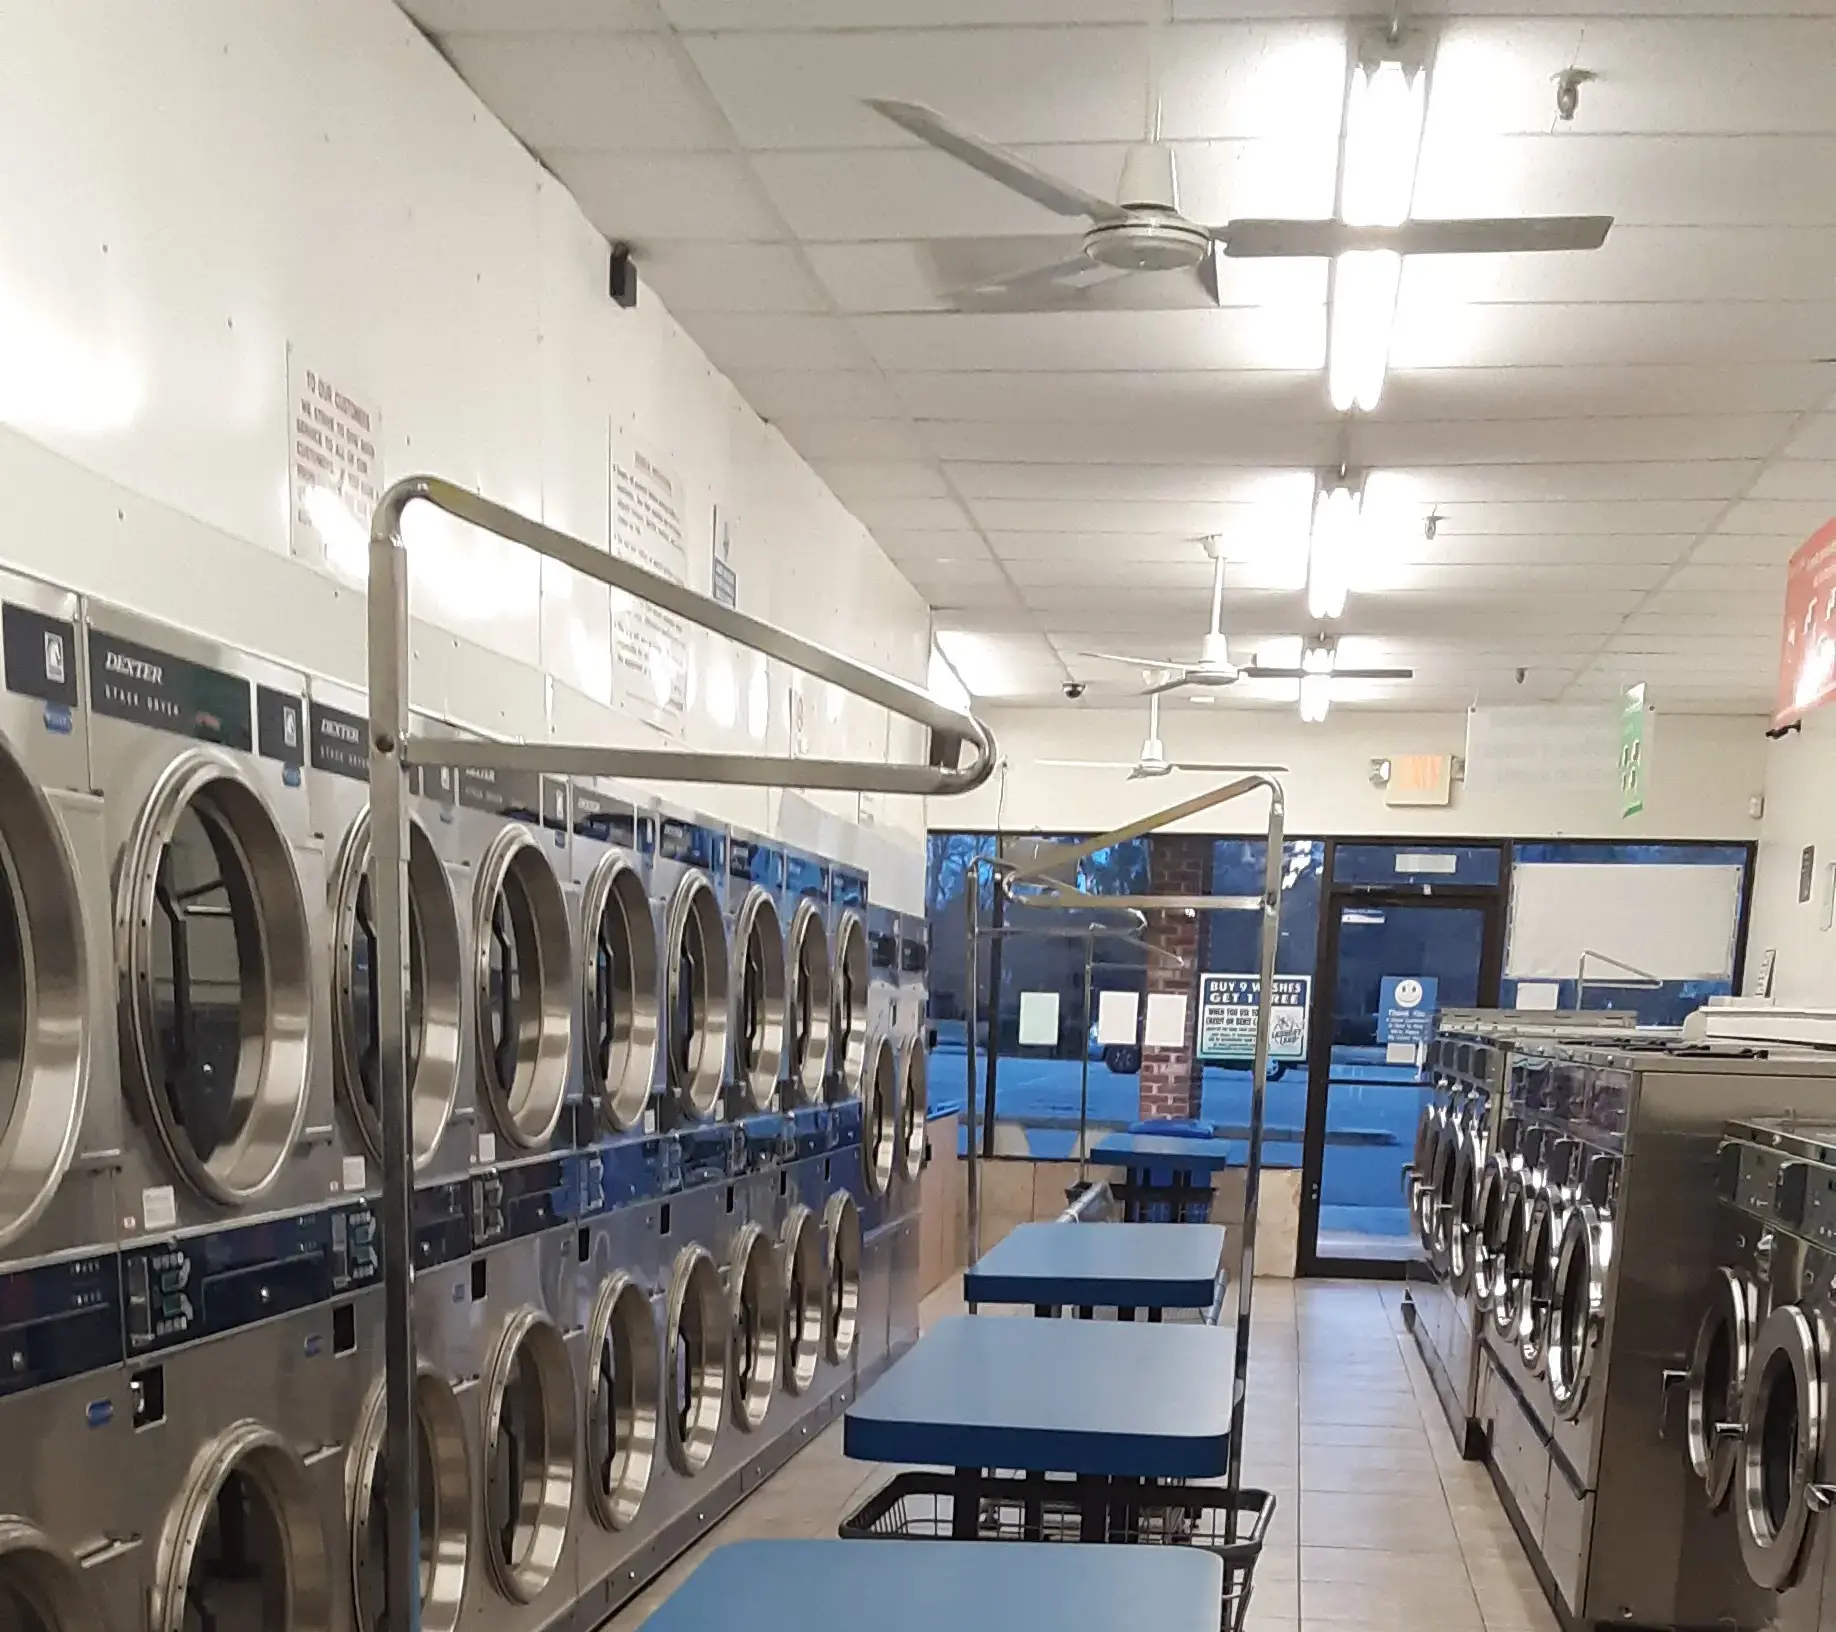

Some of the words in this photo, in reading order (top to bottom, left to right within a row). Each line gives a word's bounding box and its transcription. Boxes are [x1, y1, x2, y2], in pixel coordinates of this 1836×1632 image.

[105, 651, 164, 685] DEXTER
[105, 684, 140, 707] STACK
[147, 696, 180, 717] DRYER
[321, 718, 360, 745] DEXTER
[1209, 993, 1240, 1004] GET
[1246, 993, 1254, 1004] 1
[1271, 994, 1300, 1005] REE
[1210, 981, 1236, 992] BUY
[1239, 981, 1248, 993] 9
[1251, 982, 1302, 994] WSHES
